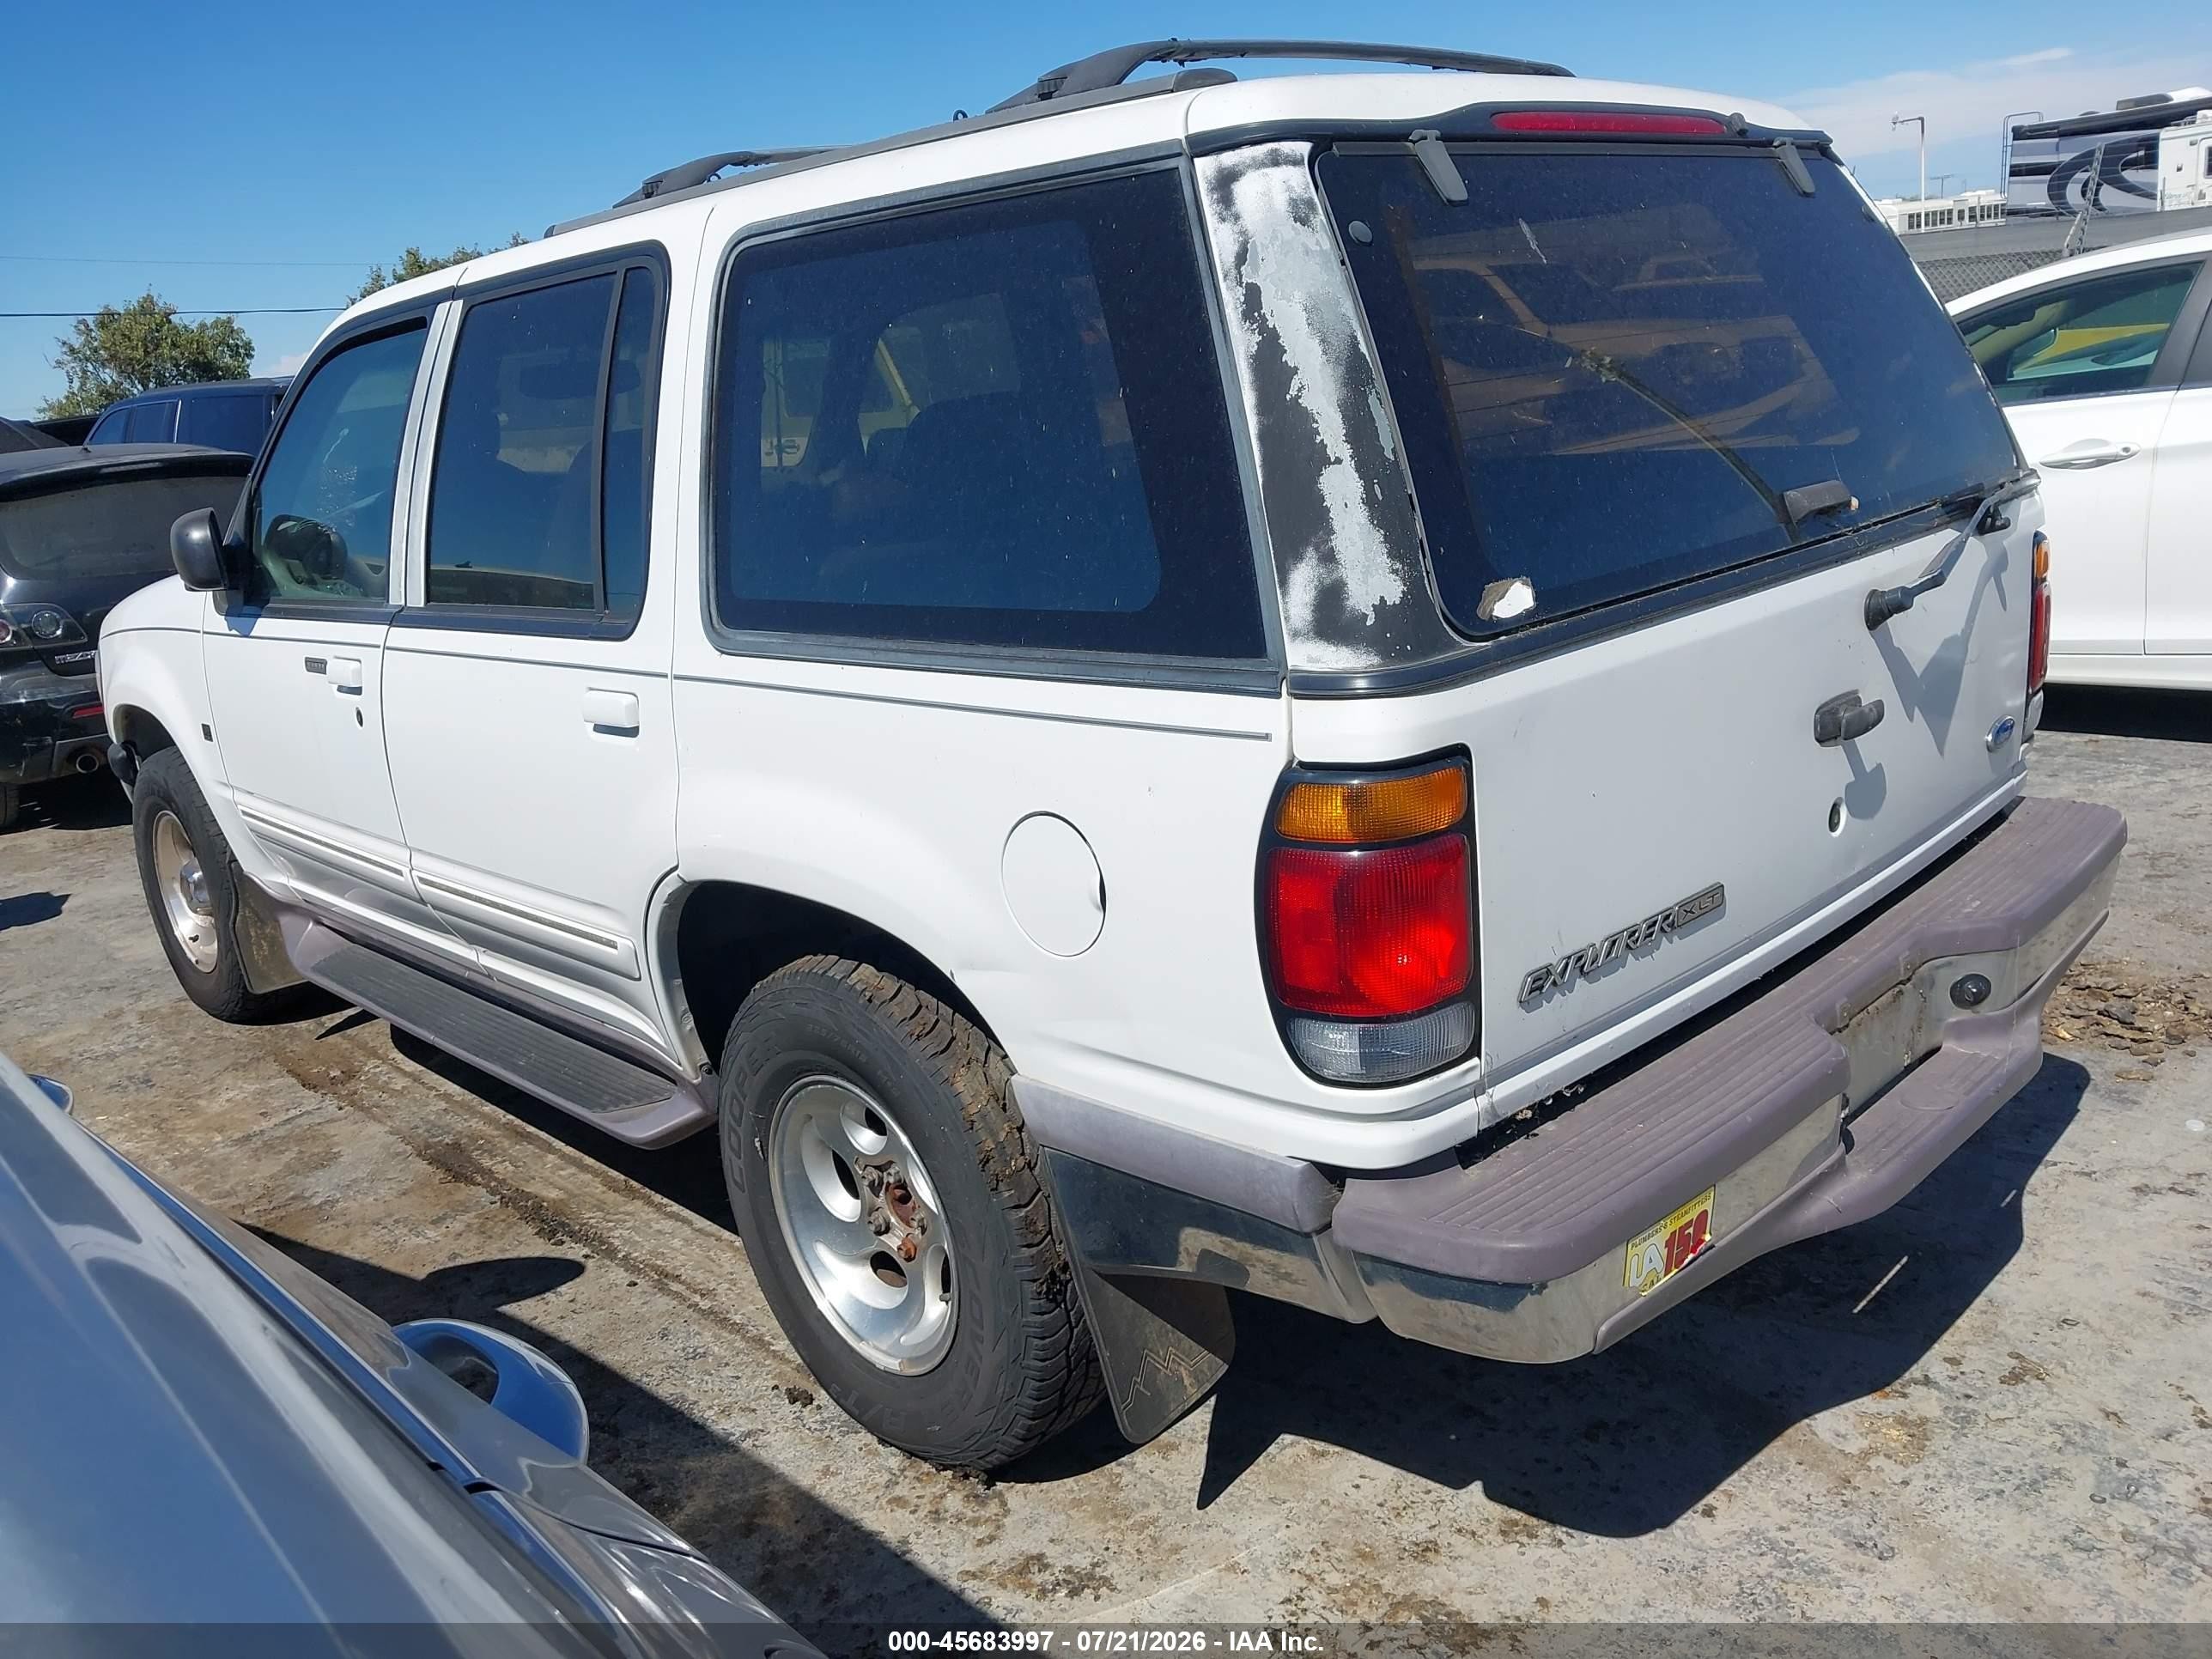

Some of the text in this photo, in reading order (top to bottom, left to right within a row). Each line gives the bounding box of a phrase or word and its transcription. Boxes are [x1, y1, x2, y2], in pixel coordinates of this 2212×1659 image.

[1518, 890, 1722, 1003] EXPLORER XLT
[1631, 1225, 1662, 1250] PLUMBERS
[1669, 1192, 1711, 1226] STEAMFITTERS
